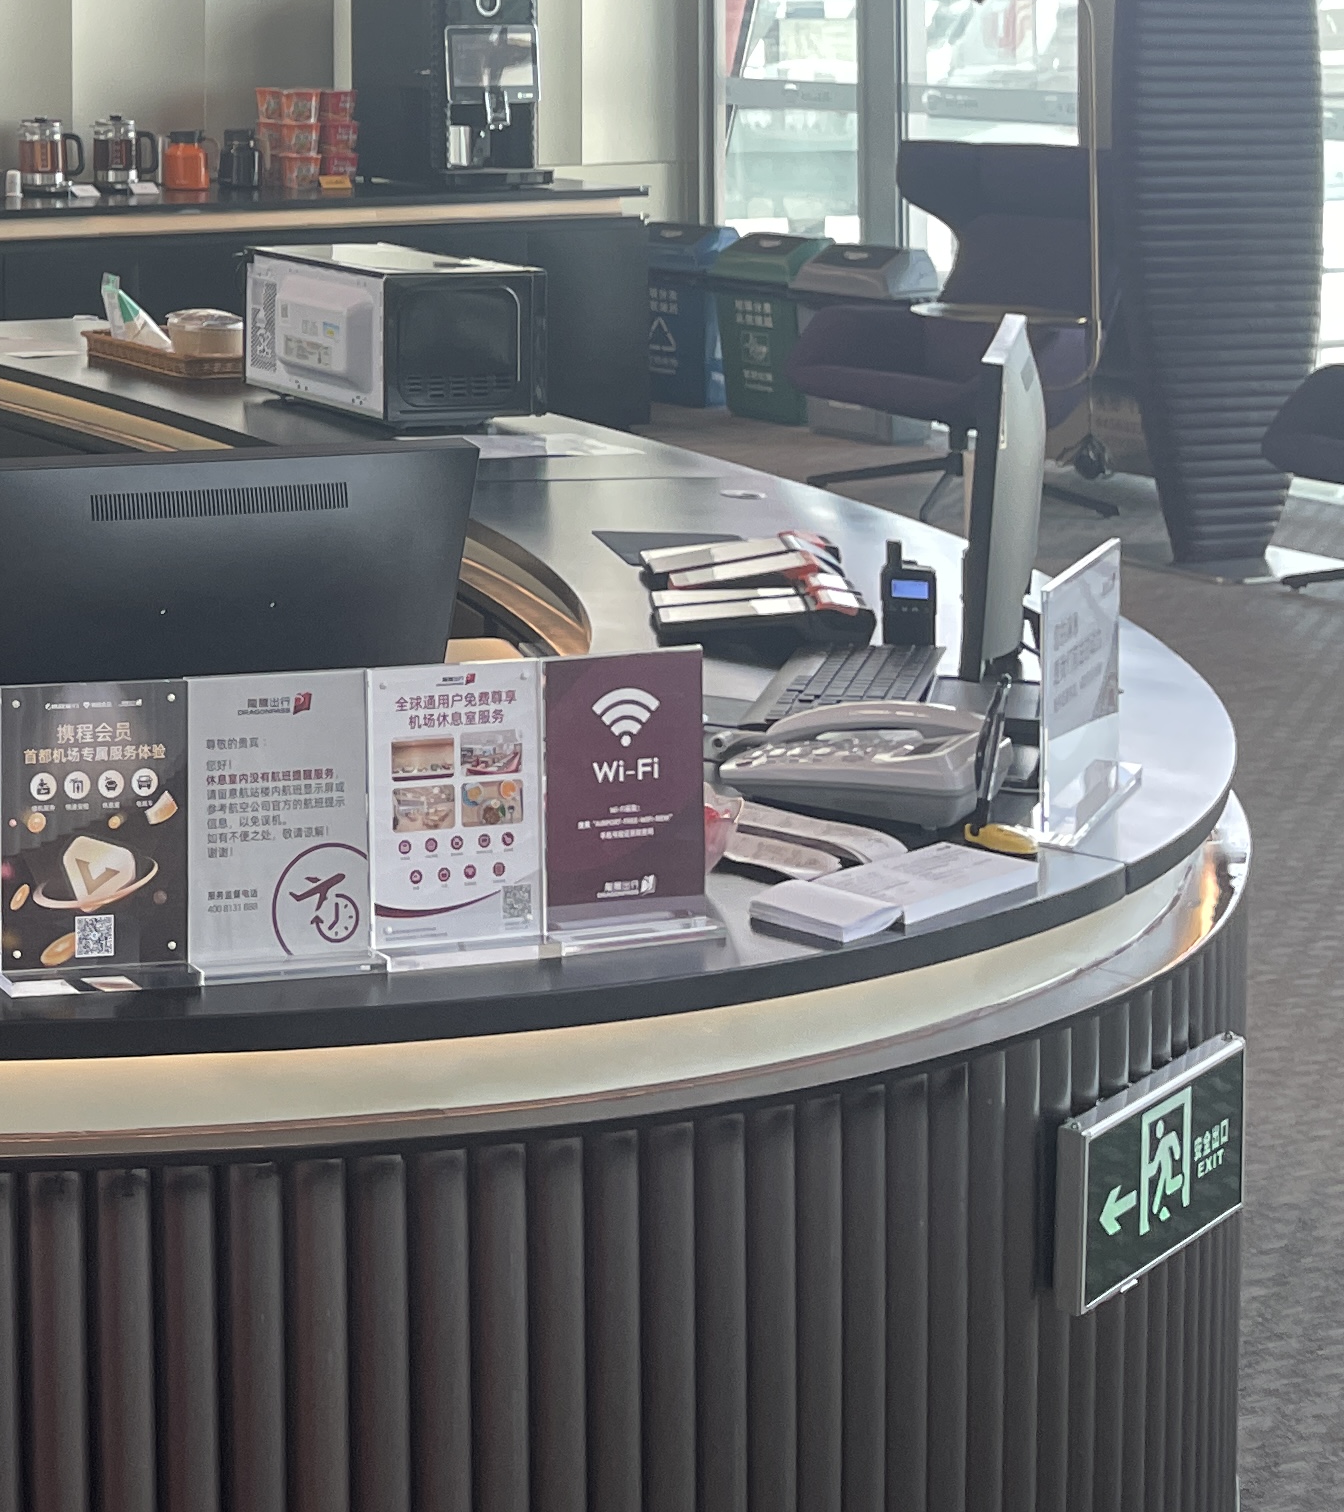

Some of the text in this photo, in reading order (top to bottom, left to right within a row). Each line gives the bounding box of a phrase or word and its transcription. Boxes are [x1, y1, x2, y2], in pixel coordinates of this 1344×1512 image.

[408, 708, 504, 729] 机场休息室服务
[57, 722, 131, 744] 携程会员
[24, 744, 166, 765] 首都机场专属服务体验
[593, 757, 660, 783] Wi-Fi
[1194, 1118, 1229, 1162] 安全出口
[1197, 1148, 1225, 1178] EXIT
